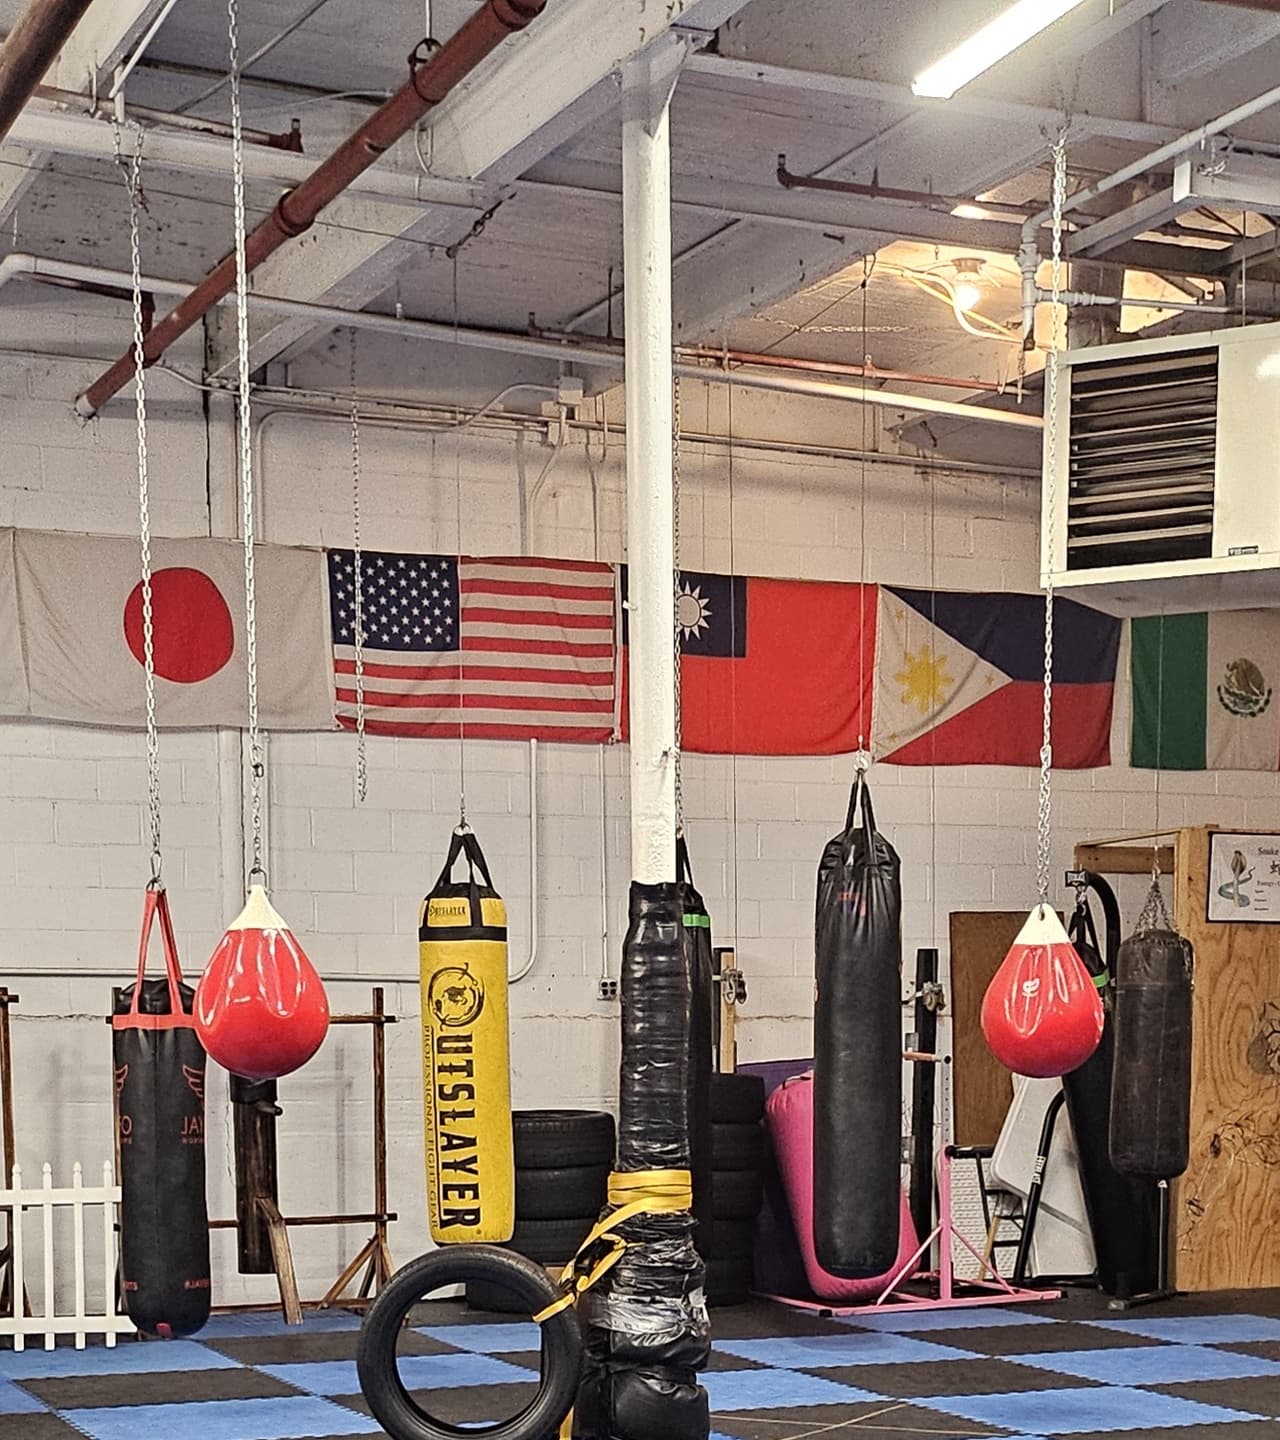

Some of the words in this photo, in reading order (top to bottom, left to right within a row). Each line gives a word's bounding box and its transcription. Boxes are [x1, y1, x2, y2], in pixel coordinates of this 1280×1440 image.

[423, 1025, 435, 1133] PROFESSIONAL
[426, 1138, 437, 1186] FIGHT
[428, 1189, 439, 1230] GEAR
